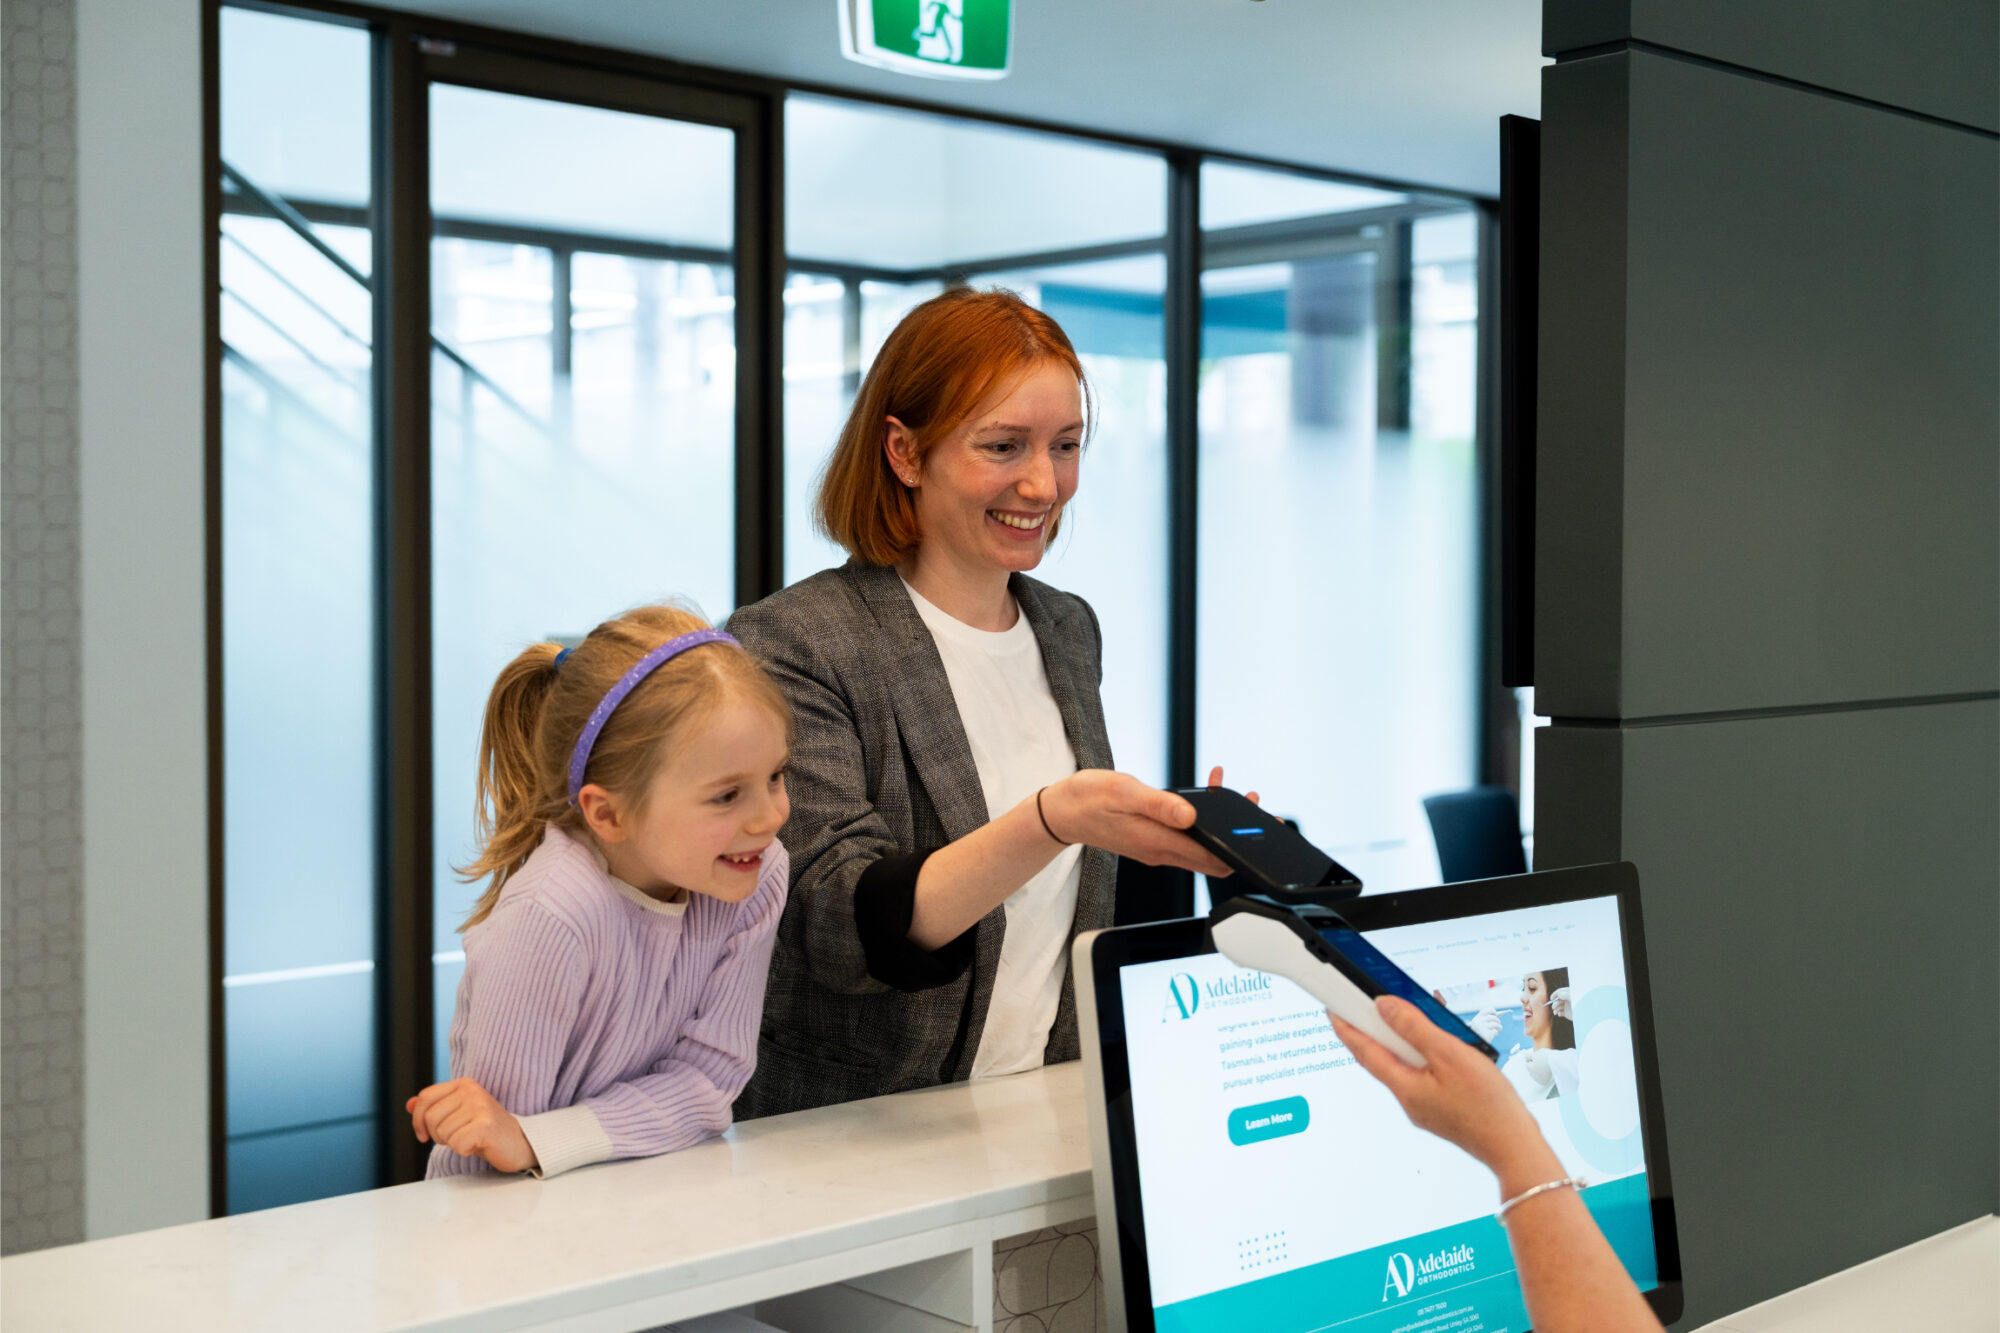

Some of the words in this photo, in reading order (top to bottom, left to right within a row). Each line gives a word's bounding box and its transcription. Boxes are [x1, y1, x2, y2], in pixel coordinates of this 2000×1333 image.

[1203, 971, 1272, 1000] Adelaide
[1204, 992, 1273, 1010] ORTHODONTICS
[1219, 1037, 1253, 1054] gaining
[1255, 1031, 1291, 1045] valuable
[1292, 1023, 1333, 1039] experienc
[1221, 1055, 1265, 1071] Tasmania,
[1266, 1051, 1278, 1062] he
[1279, 1044, 1317, 1060] returned
[1318, 1043, 1327, 1052] to
[1328, 1039, 1345, 1051] Sou
[1223, 1076, 1253, 1091] pursue
[1255, 1067, 1296, 1083] specialist
[1297, 1057, 1346, 1075] orthodontic
[1245, 1117, 1270, 1131] Learn
[1271, 1112, 1294, 1125] More
[1416, 1244, 1474, 1276] Adelaide
[1417, 1262, 1475, 1285] ORTHODONTICS
